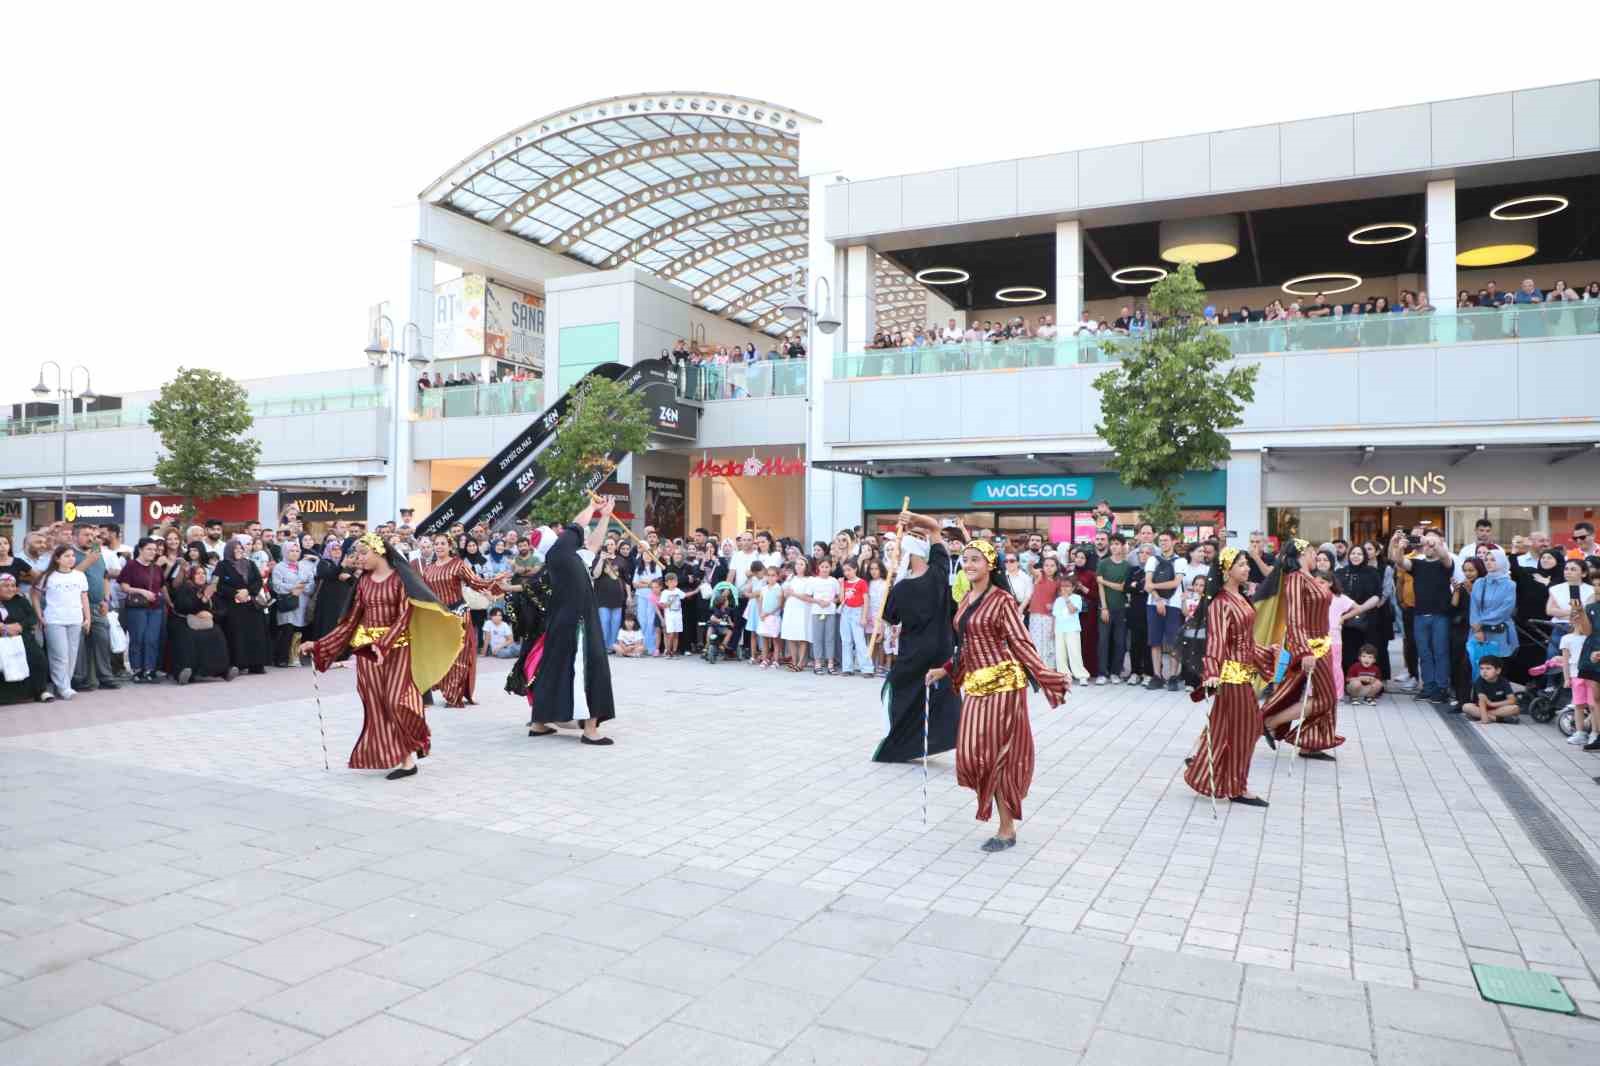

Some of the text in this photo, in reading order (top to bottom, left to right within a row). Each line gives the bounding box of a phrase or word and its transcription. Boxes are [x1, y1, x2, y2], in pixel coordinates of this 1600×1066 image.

[543, 409, 558, 427] ZEN
[659, 406, 679, 422] ZEN
[467, 475, 487, 498] ZEN
[516, 468, 534, 491] ZEN
[1350, 471, 1447, 496] COLIN'S
[986, 483, 1078, 498] watsons
